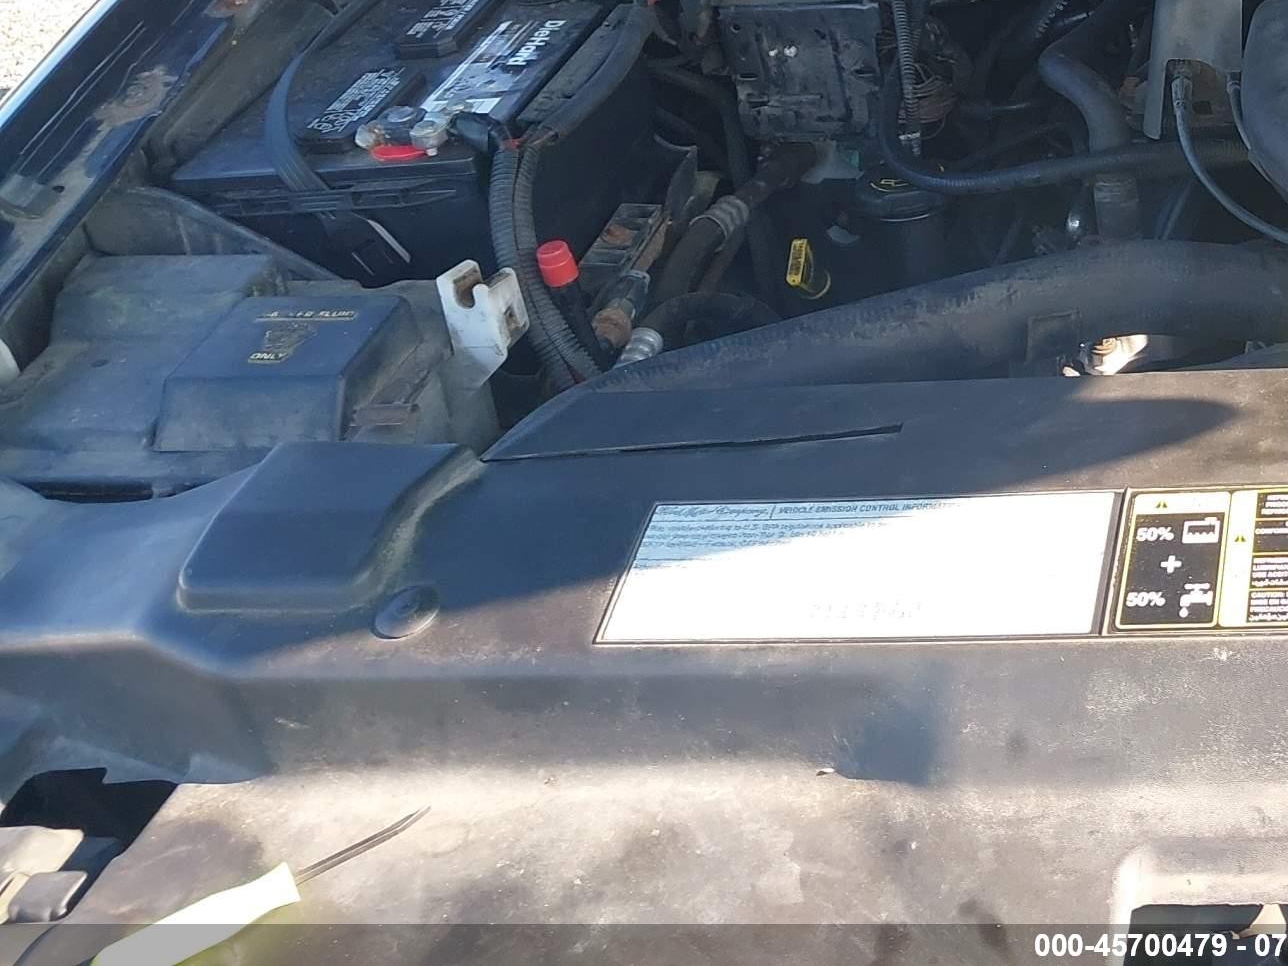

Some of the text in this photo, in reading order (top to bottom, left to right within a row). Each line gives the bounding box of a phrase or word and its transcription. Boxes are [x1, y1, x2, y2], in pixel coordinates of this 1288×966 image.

[506, 20, 567, 66] DieHard
[249, 352, 289, 360] ONLY
[1136, 526, 1175, 542] 50%
[1126, 591, 1166, 607] 50%
